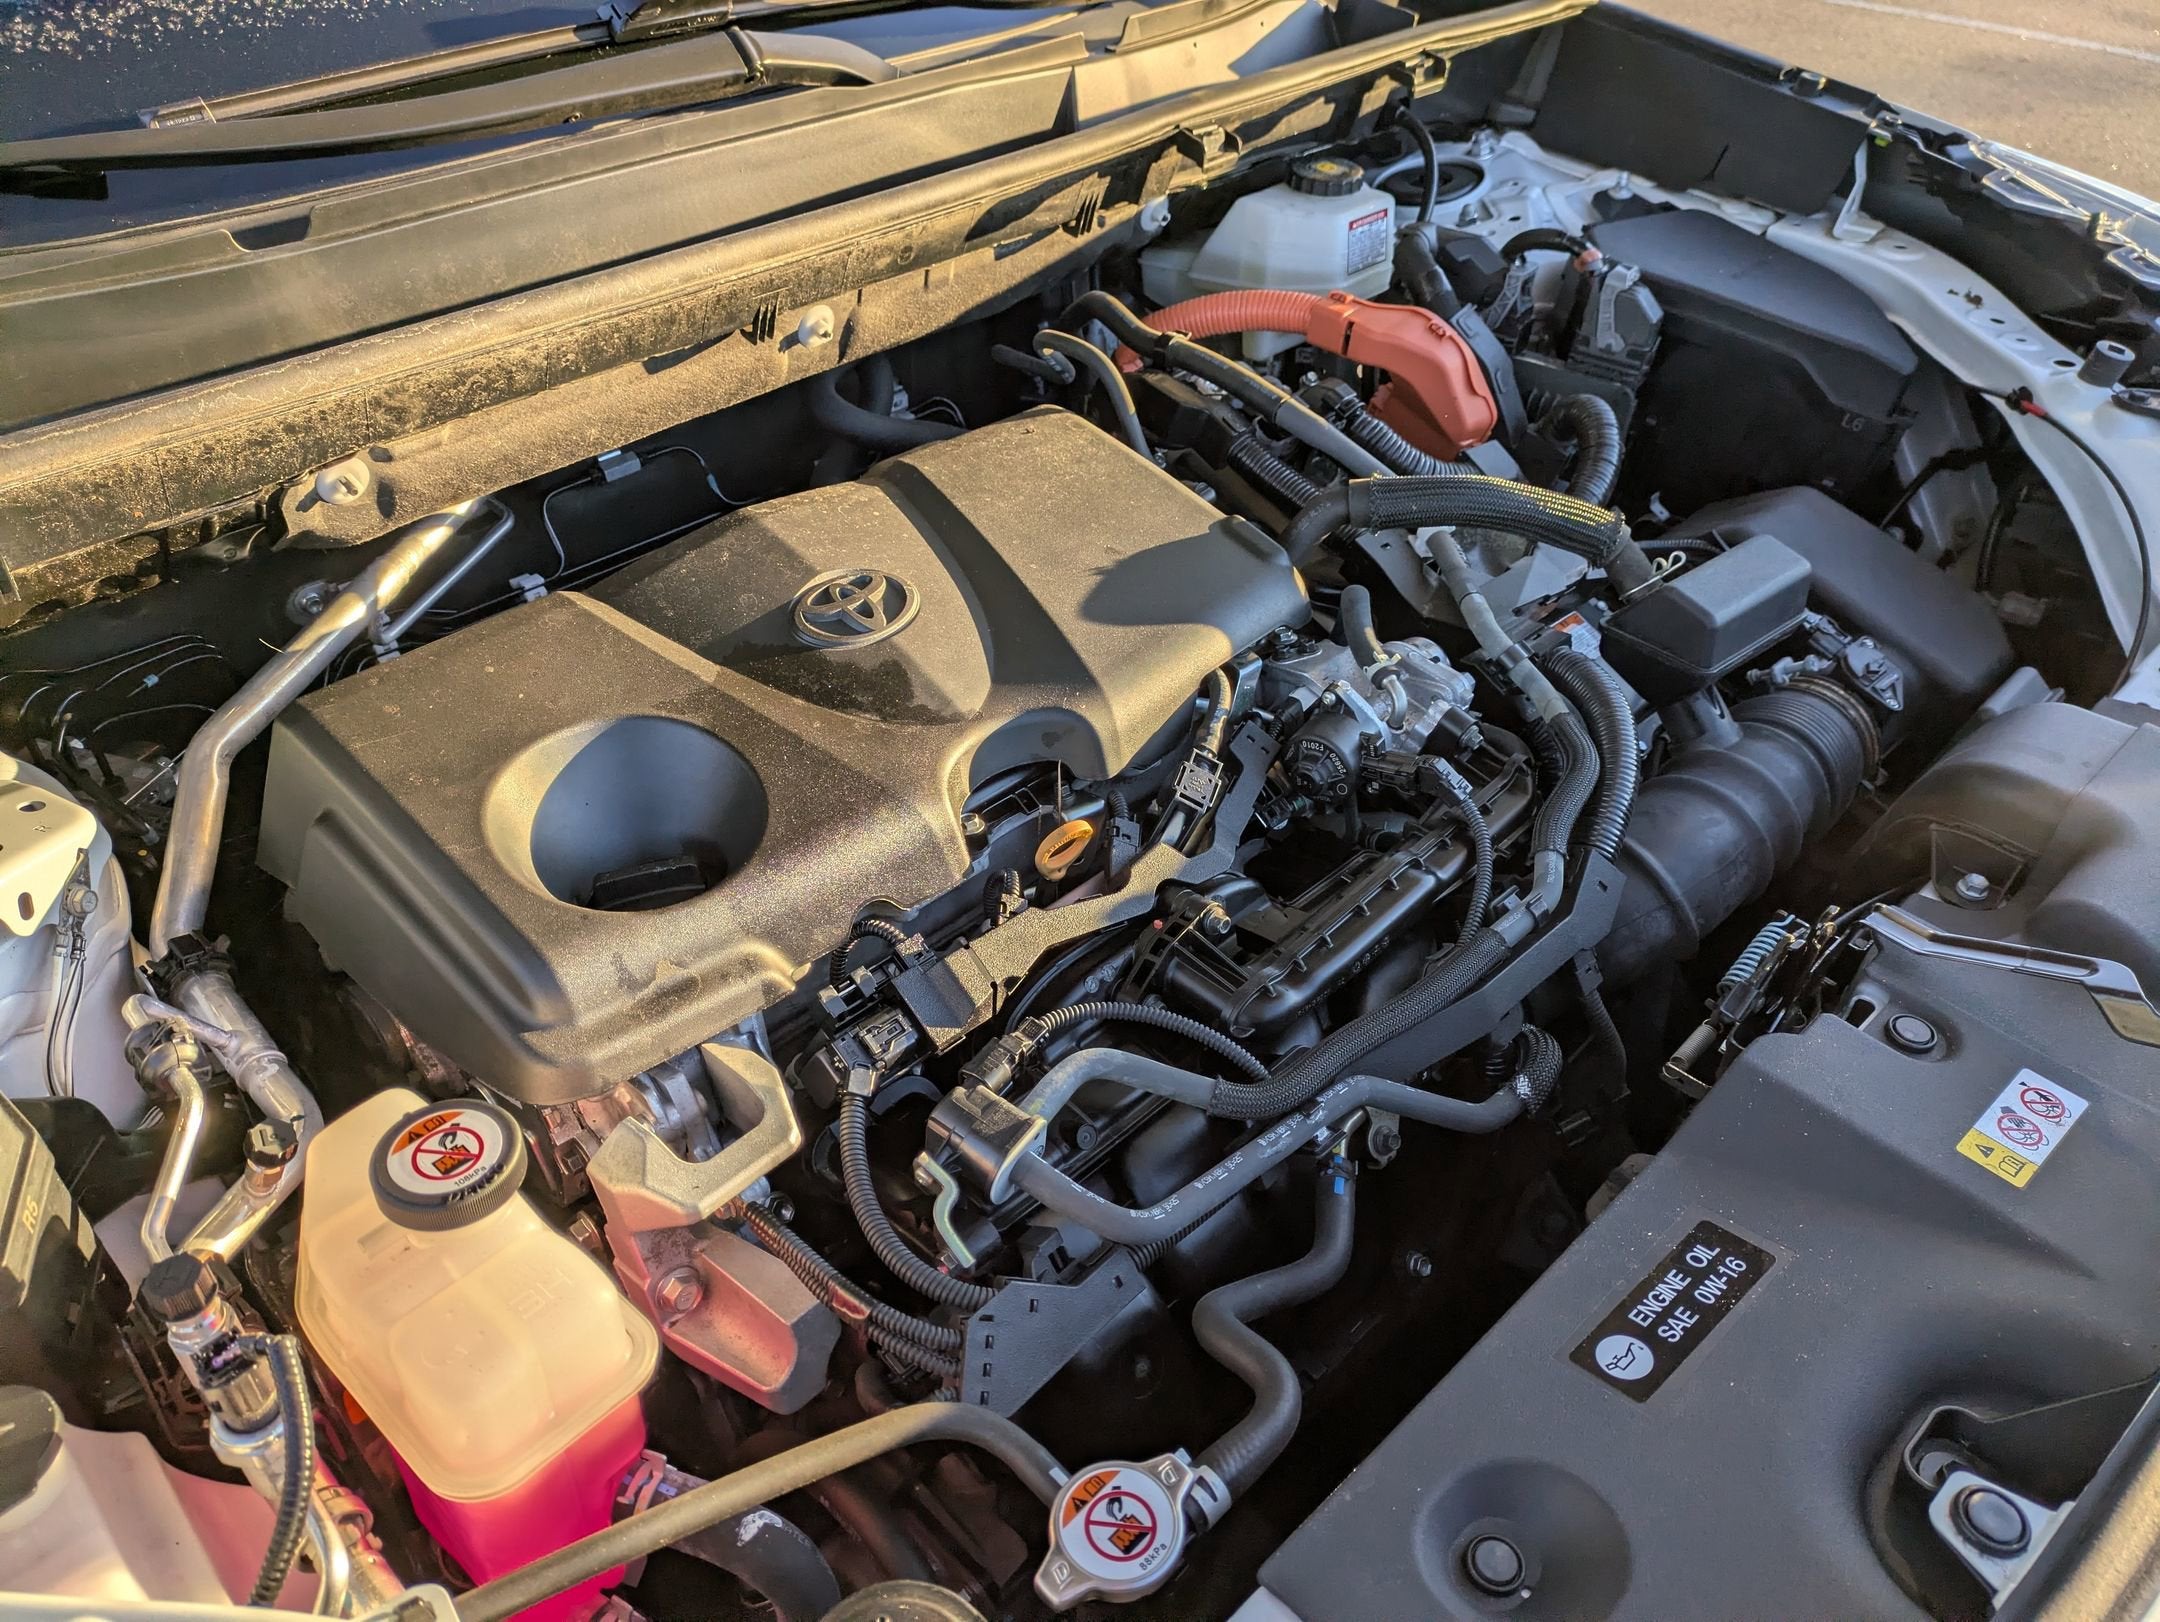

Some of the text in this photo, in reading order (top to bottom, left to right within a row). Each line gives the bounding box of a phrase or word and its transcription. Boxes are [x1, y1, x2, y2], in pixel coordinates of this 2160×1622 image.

[1627, 1244, 1721, 1328] ENGINE OIL
[1657, 1256, 1747, 1343] SAE 0W-16
[1139, 1543, 1168, 1571] 88kPa
